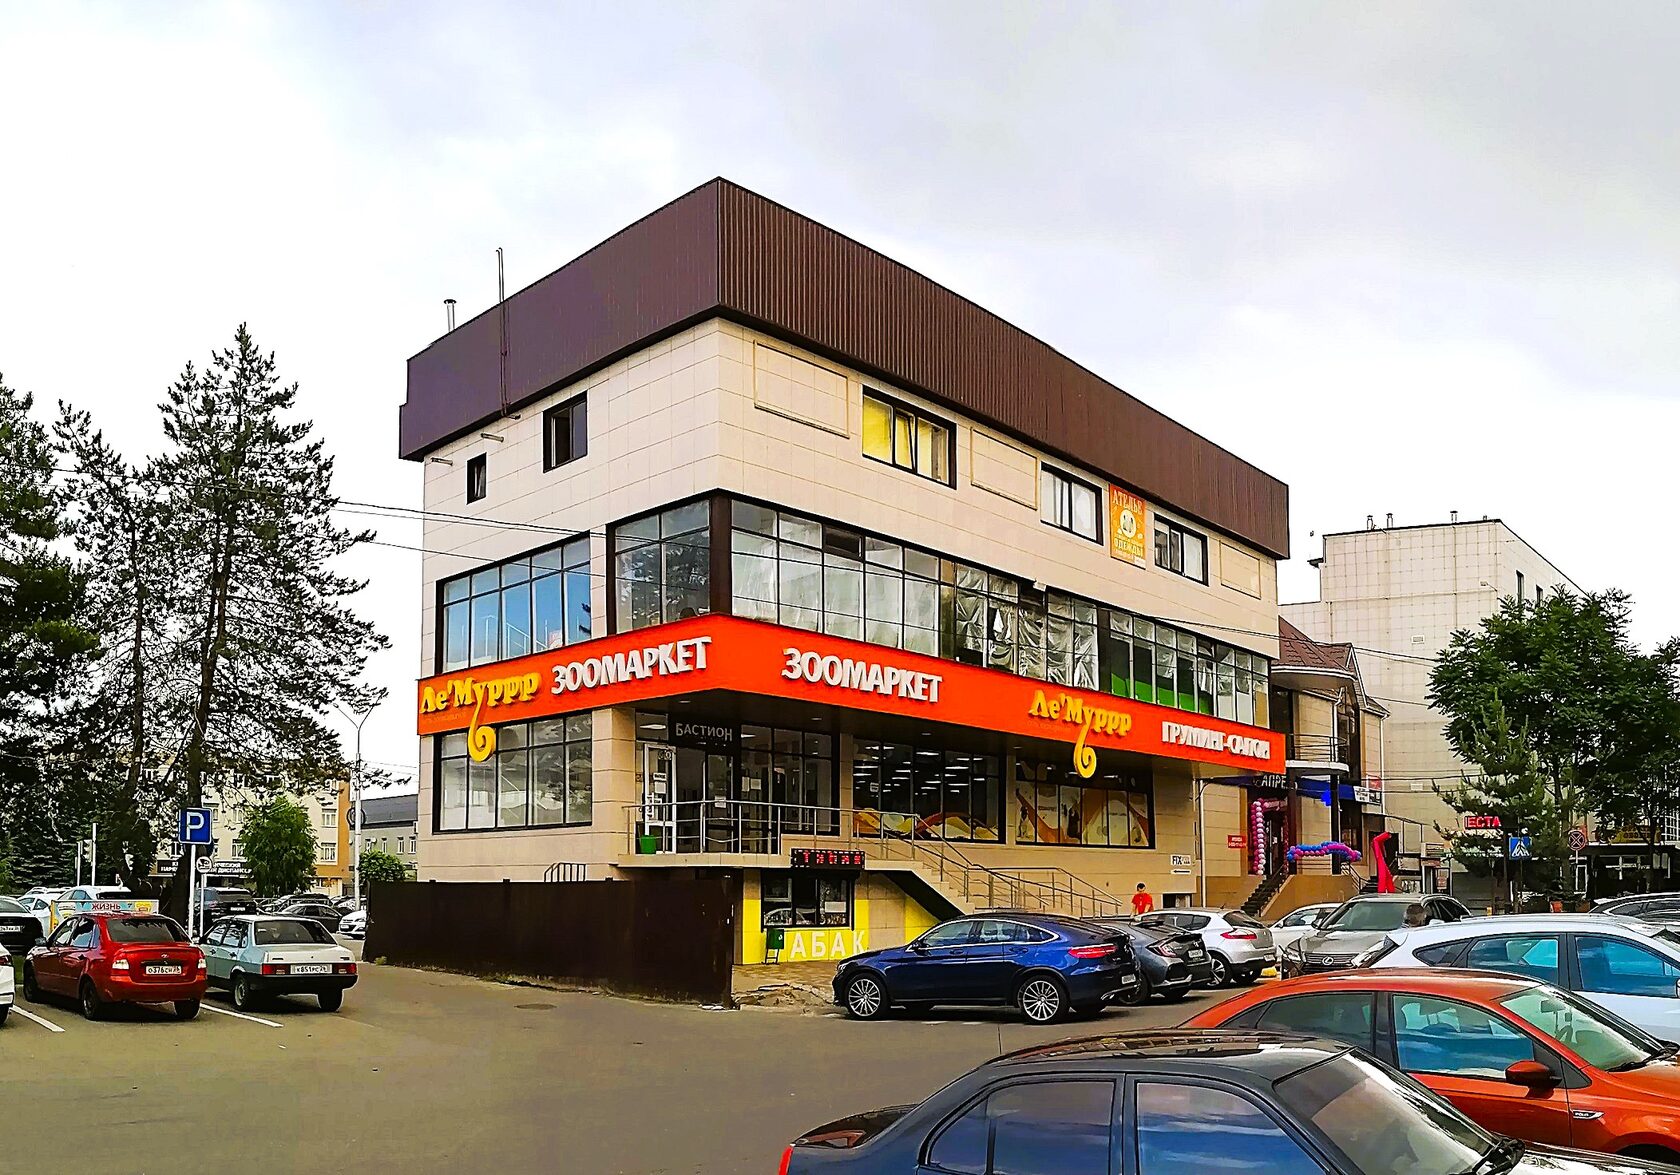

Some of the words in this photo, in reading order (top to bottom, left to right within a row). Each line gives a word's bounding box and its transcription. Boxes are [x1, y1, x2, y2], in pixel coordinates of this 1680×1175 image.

[551, 636, 712, 695] ЗООМАРКЕТ
[781, 647, 943, 703] ЗООМАРКЕТ
[675, 722, 733, 742] БАСТИОН
[1162, 721, 1270, 760] ГРУМИНГ-САЛОН
[1261, 774, 1298, 790] АПРЕ
[91, 902, 121, 911] ЖИЗНЬ
[789, 930, 866, 959] АБАК
